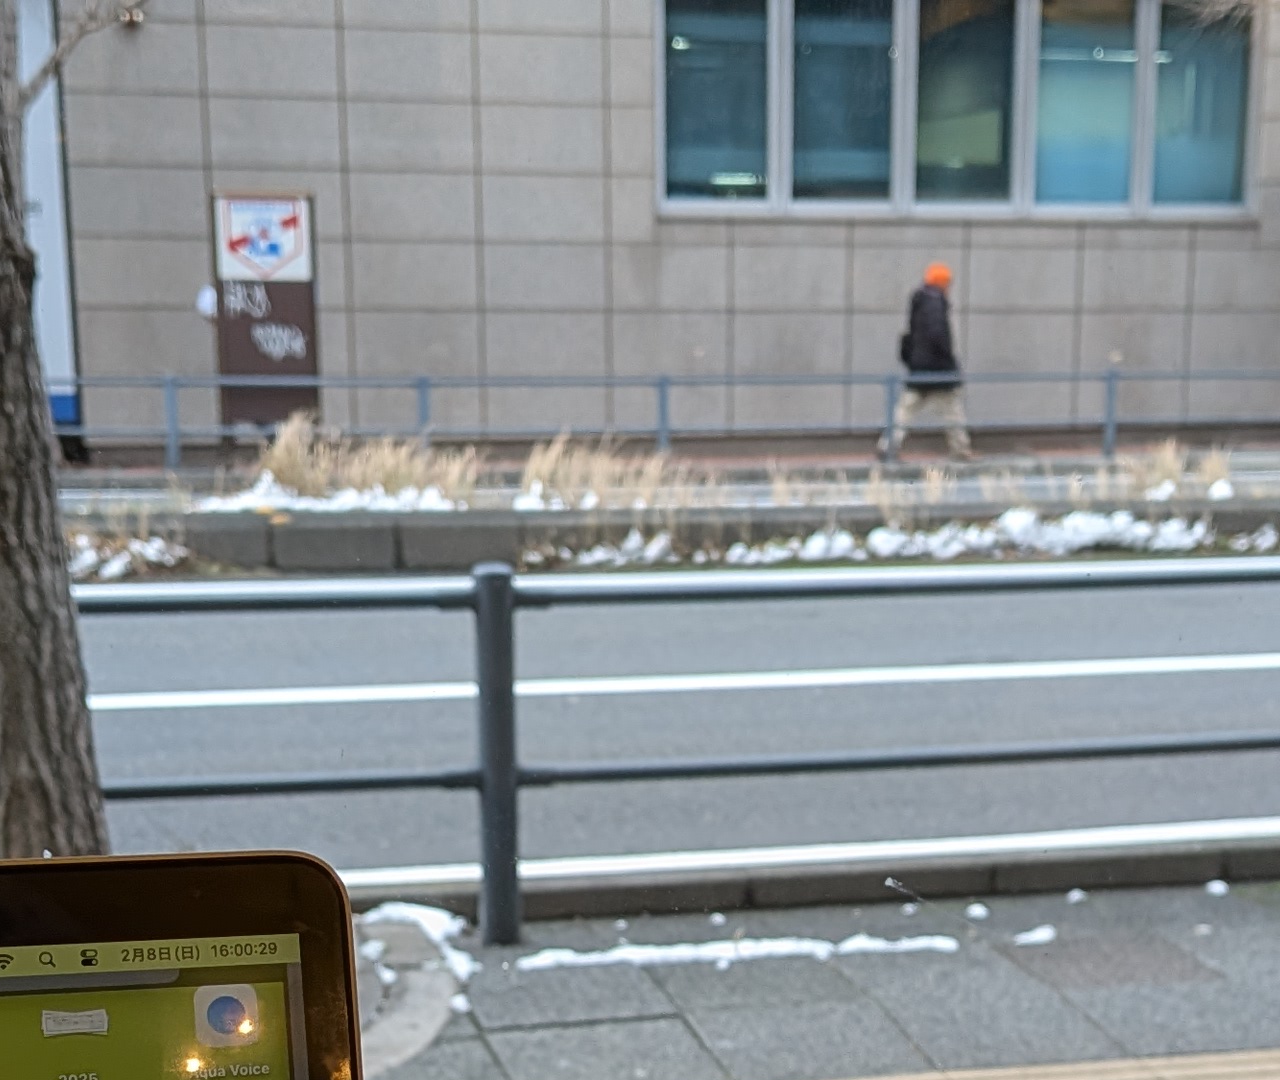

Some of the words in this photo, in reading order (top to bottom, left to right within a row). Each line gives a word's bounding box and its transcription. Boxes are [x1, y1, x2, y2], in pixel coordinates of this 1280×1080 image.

[121, 945, 200, 963] 2月8日(日)
[210, 942, 278, 958] 16:00:29
[230, 1063, 270, 1078] Voice
